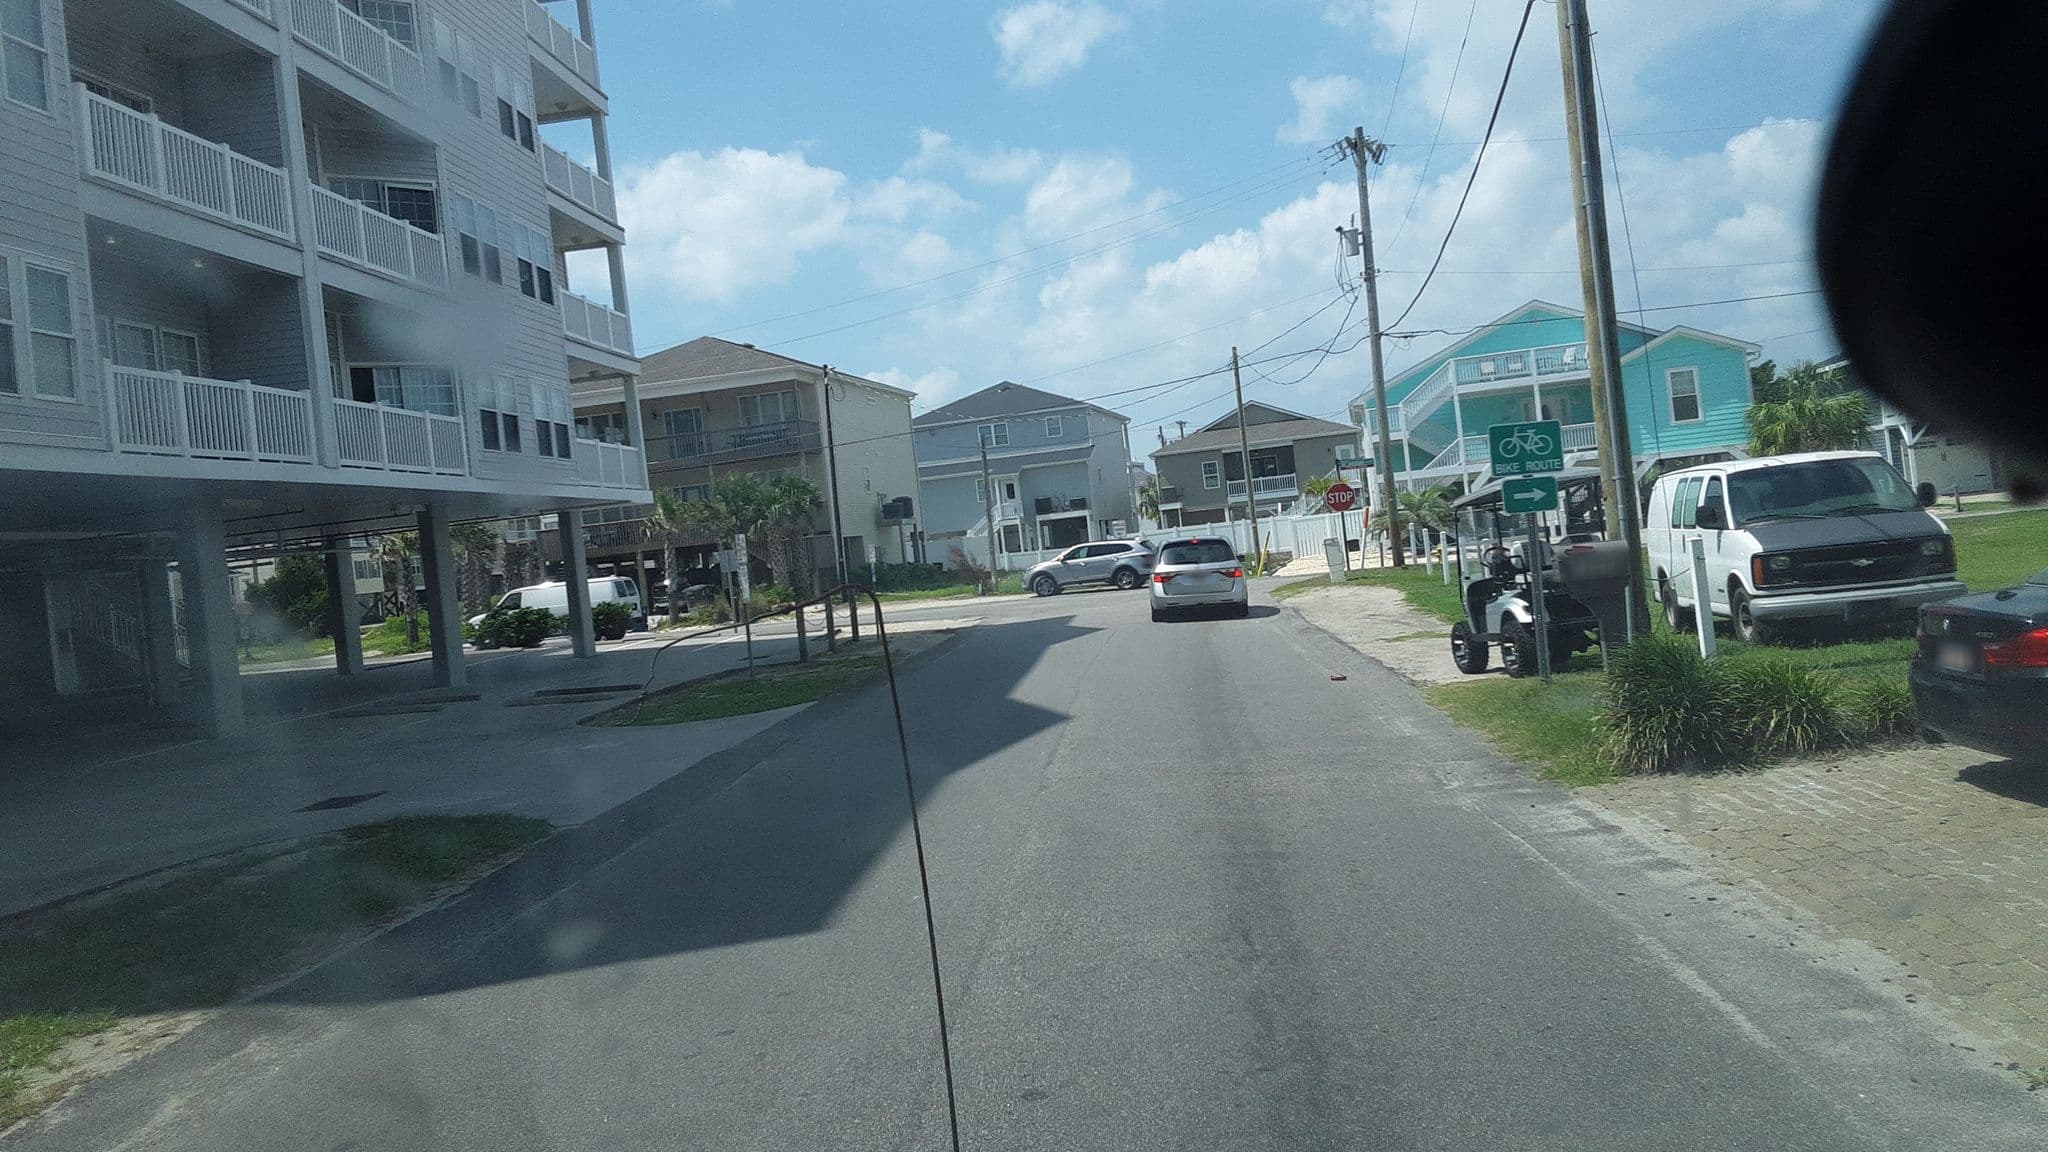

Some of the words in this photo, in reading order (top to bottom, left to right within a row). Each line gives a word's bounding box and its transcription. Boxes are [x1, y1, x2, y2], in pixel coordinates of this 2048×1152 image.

[1495, 462, 1520, 474] BIKE
[1526, 459, 1561, 471] ROUTE
[1328, 491, 1353, 504] STOP
